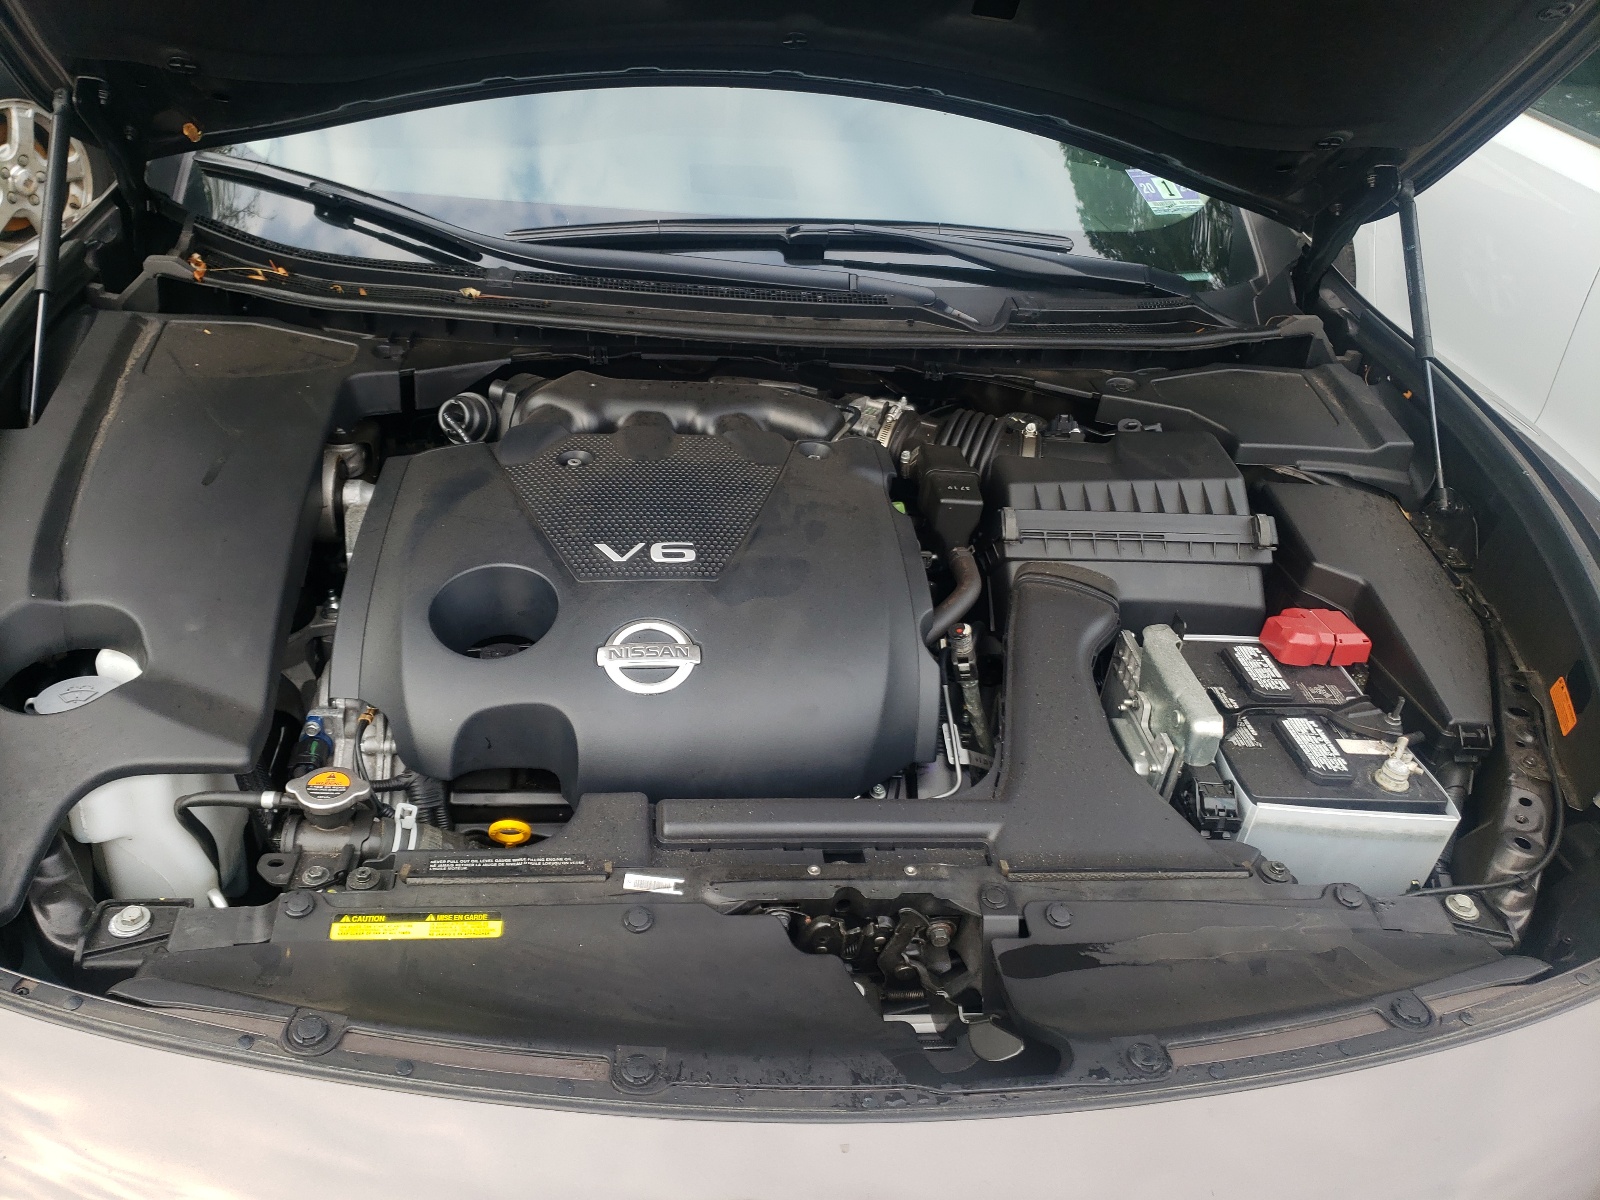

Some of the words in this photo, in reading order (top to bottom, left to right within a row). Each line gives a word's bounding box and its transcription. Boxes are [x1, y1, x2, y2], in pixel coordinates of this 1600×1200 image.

[1139, 182, 1155, 194] 20
[1161, 180, 1175, 196] 1
[594, 542, 696, 563] V6
[608, 646, 690, 660] NISSAN
[464, 913, 488, 921] GARDE
